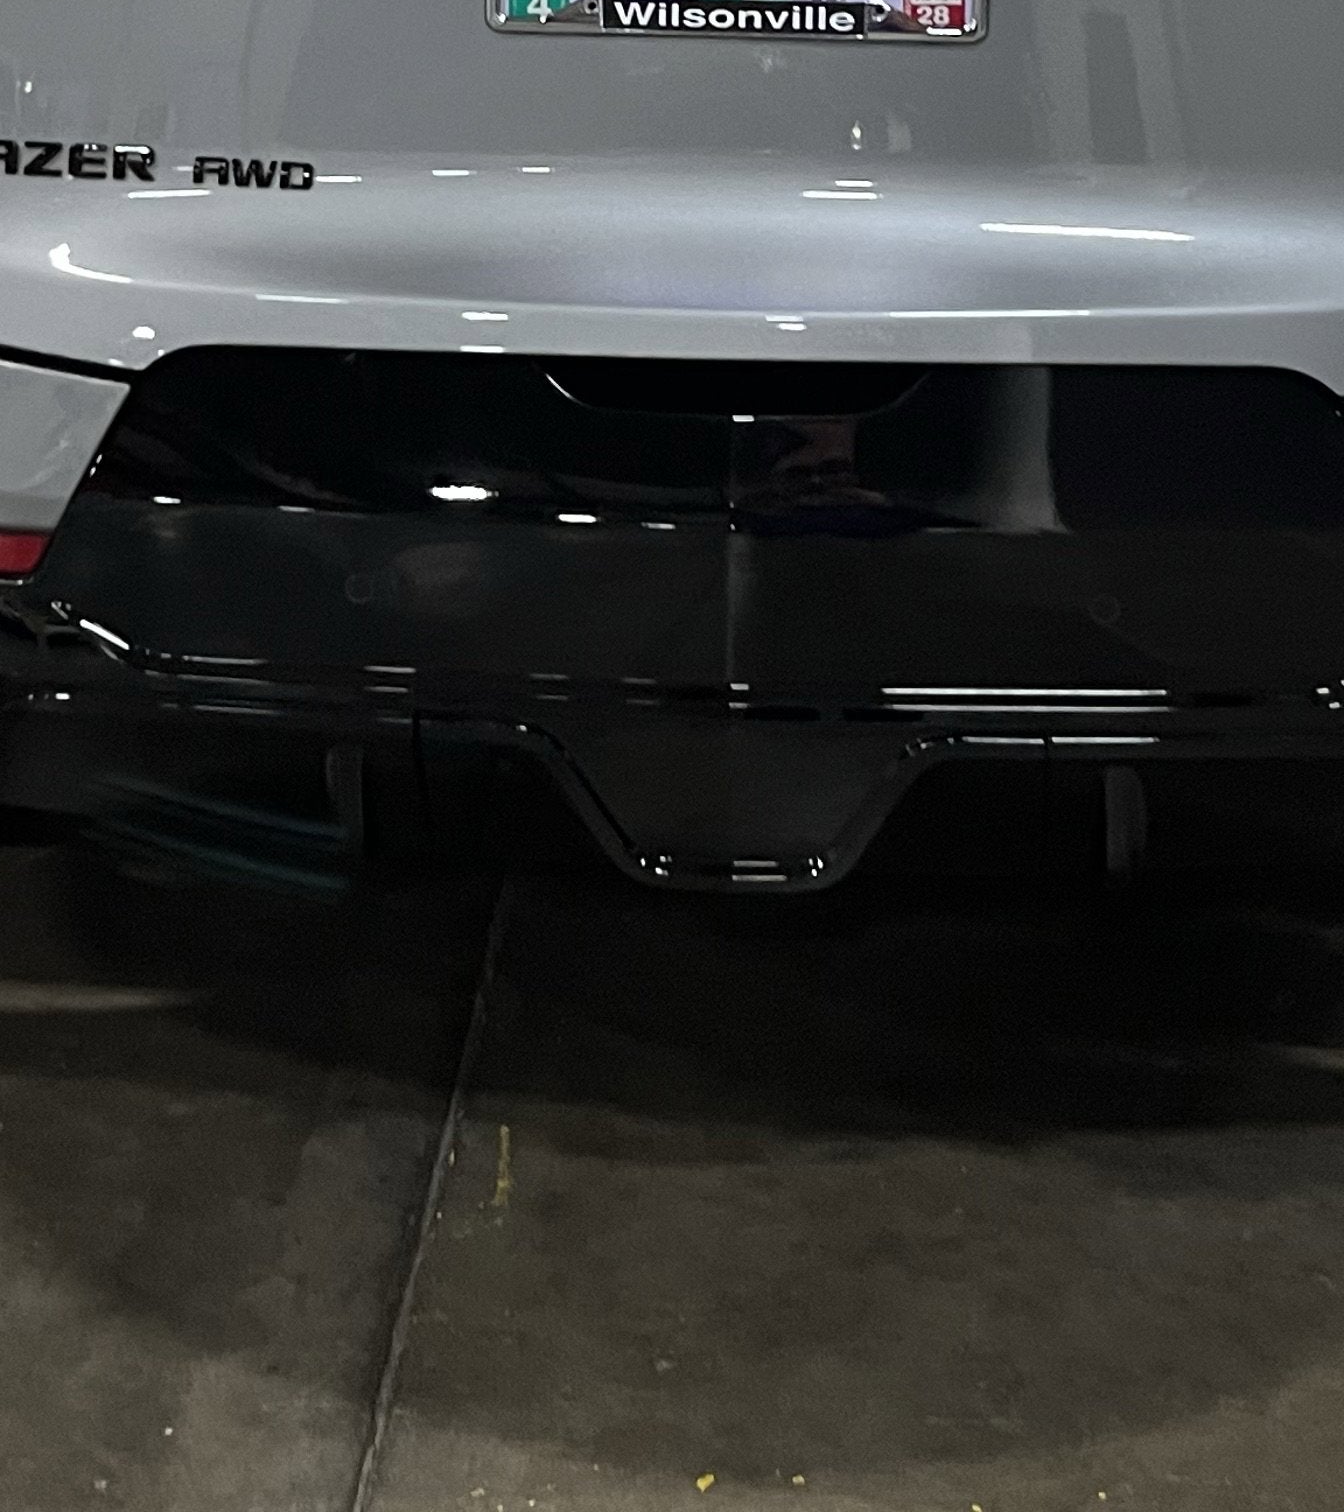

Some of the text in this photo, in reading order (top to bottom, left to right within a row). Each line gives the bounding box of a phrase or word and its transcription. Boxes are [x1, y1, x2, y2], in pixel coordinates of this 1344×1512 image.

[613, 1, 855, 31] Wilsonville
[916, 6, 950, 26] 28
[192, 155, 316, 191] AWD
